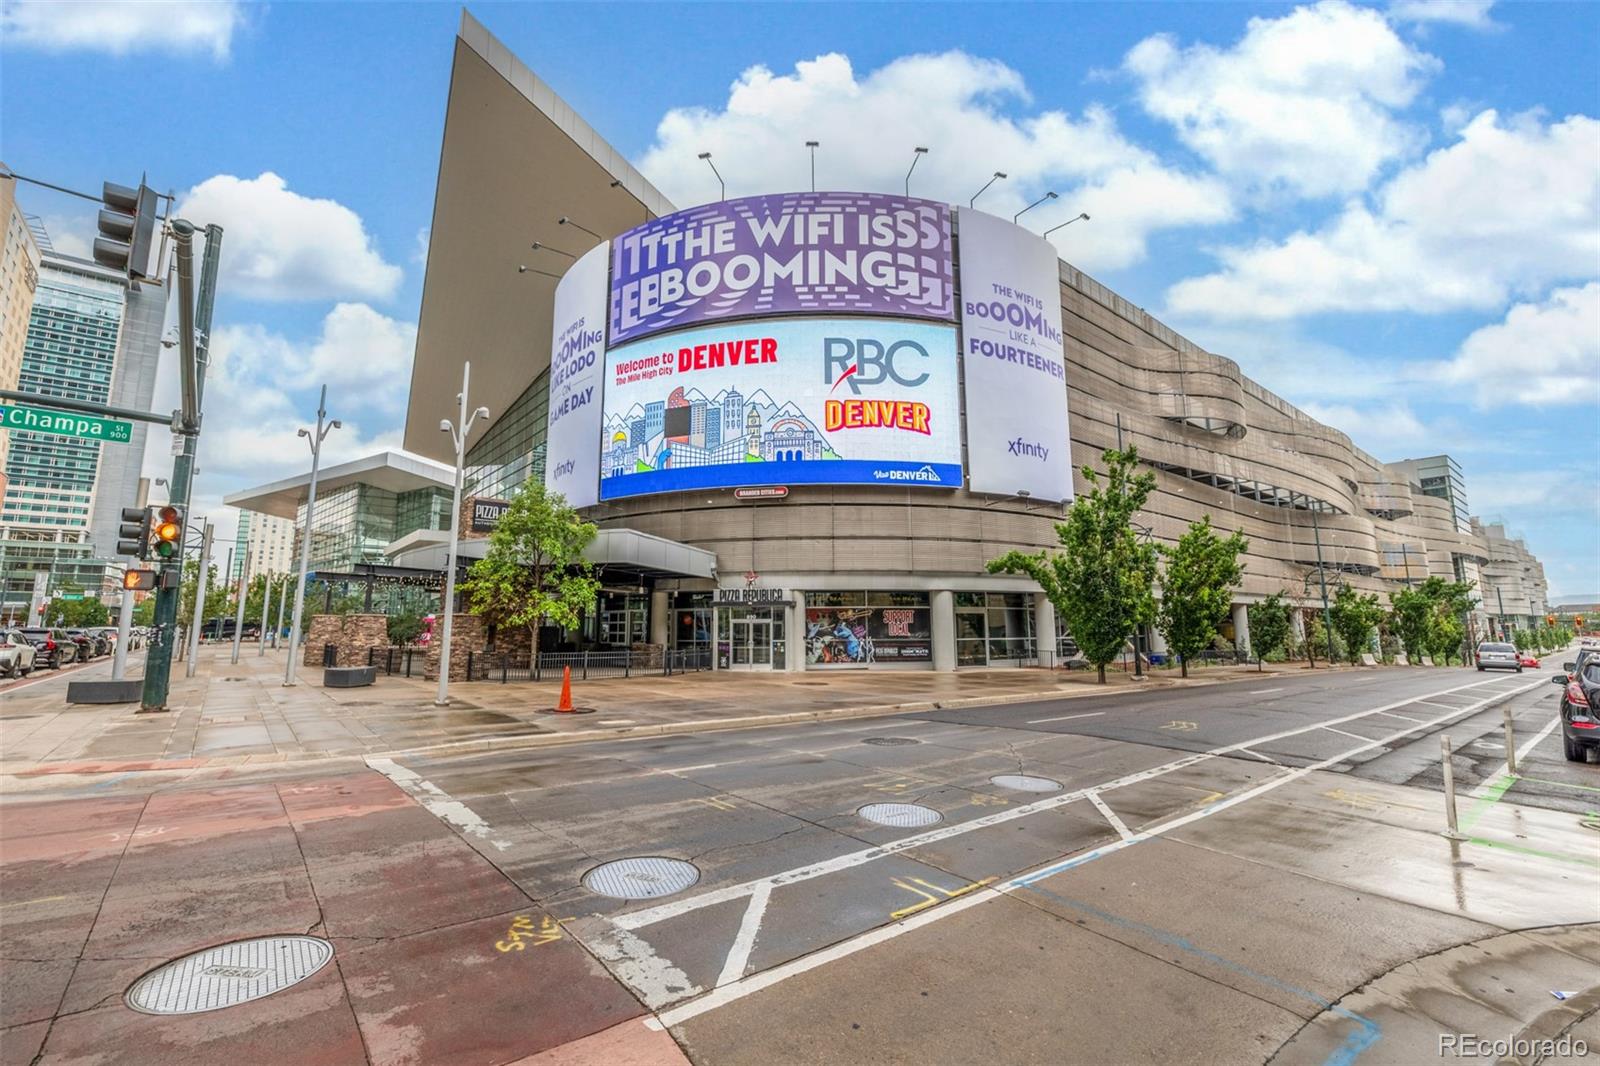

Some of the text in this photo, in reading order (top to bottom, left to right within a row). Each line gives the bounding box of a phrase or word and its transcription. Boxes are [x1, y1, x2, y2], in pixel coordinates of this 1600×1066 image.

[747, 213, 844, 248] WIFI
[992, 283, 1043, 310] THE WIFI IS
[965, 301, 1062, 345] BOOOMING
[1009, 329, 1037, 347] LIKE A
[565, 350, 596, 380] LODO
[616, 338, 778, 376] Welcome to DENVER
[823, 337, 931, 395] RBC
[969, 337, 1065, 381] FOURTEENER
[616, 366, 674, 386] The Mile High City
[571, 386, 594, 411] DAY
[9, 409, 103, 435] Champa
[825, 399, 932, 437] DENVER
[110, 431, 128, 439] 900
[1008, 437, 1050, 462] xfinity
[889, 470, 928, 481] DENVER
[475, 504, 499, 520] PIZZA
[719, 588, 740, 601] PIZZA
[742, 588, 783, 601] REPUBLICA
[883, 609, 915, 624] SUPPORT
[888, 622, 911, 637] LOCAL
